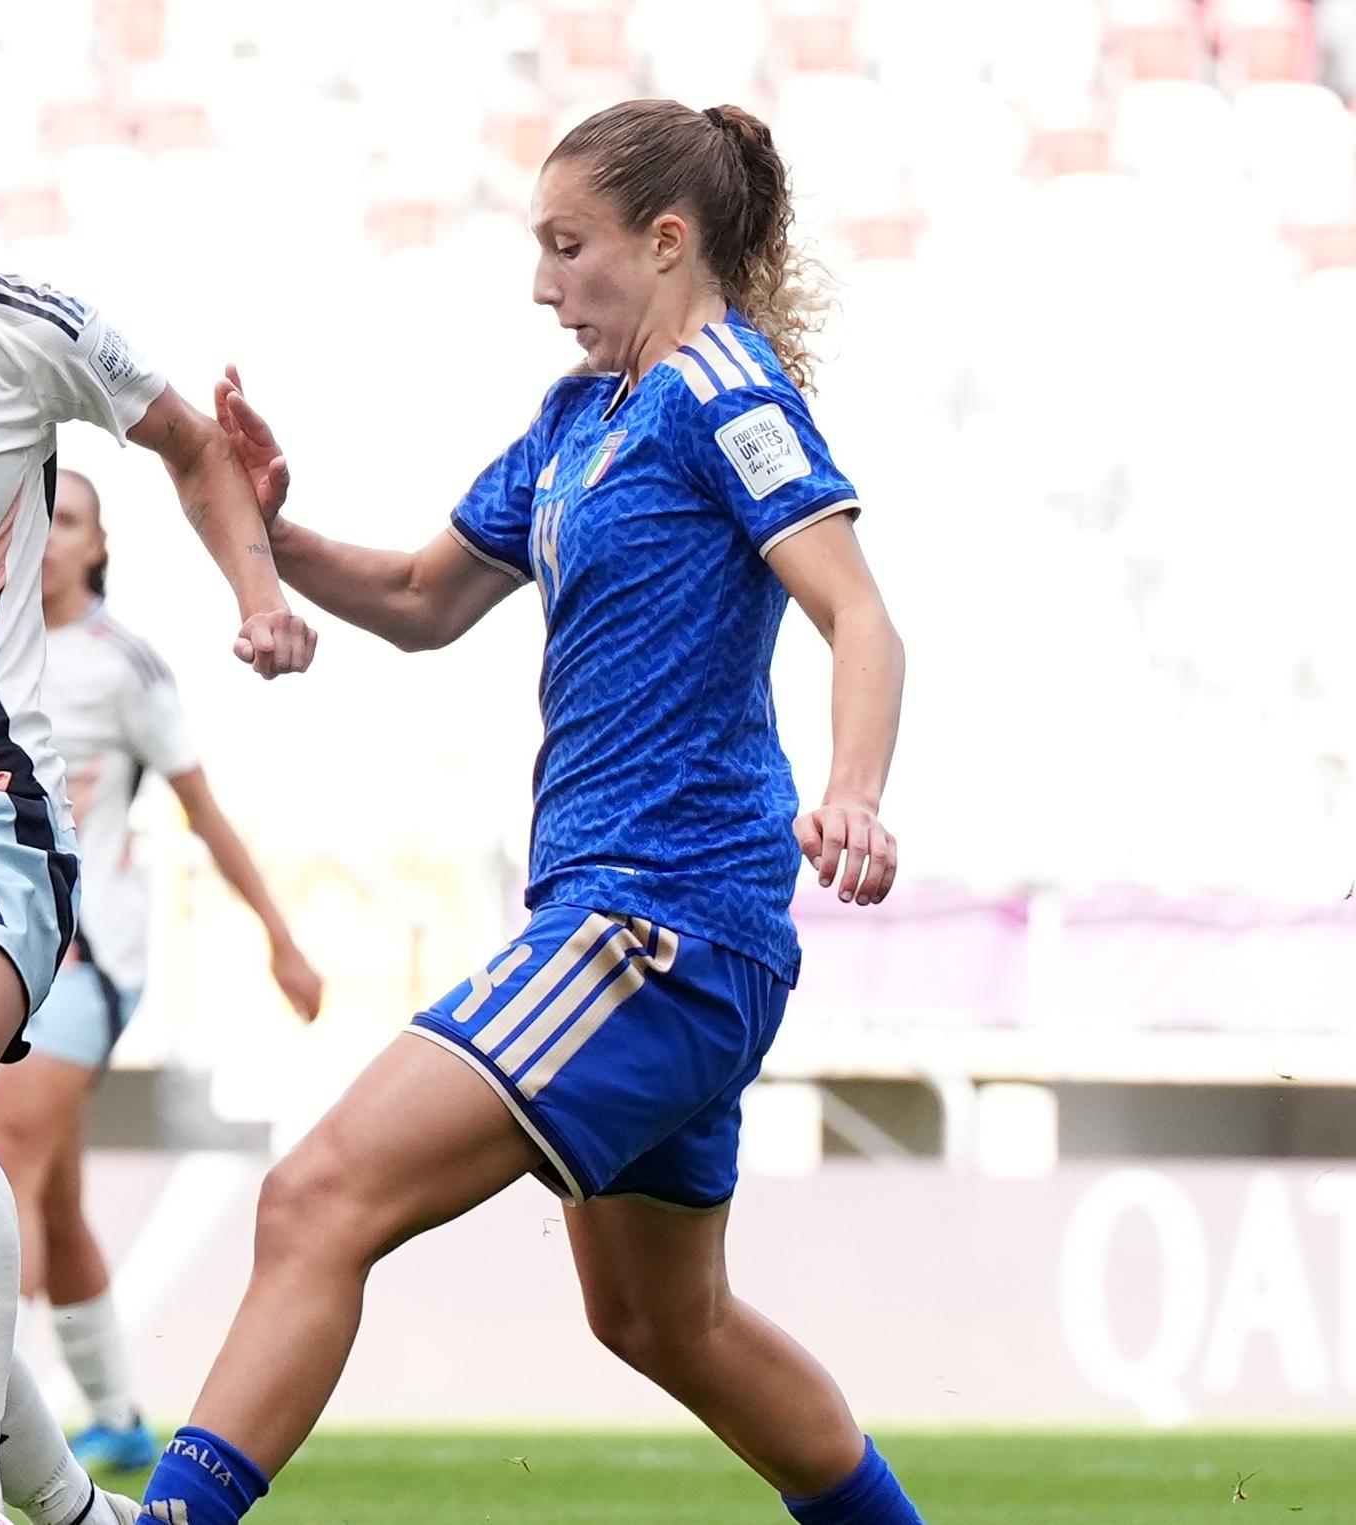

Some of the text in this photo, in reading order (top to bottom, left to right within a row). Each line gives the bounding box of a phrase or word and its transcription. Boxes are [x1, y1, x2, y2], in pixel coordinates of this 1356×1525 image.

[732, 417, 776, 447] FOOTBALL
[739, 429, 784, 461] UNITES
[748, 459, 765, 475] the
[165, 1438, 232, 1487] ITALIA
